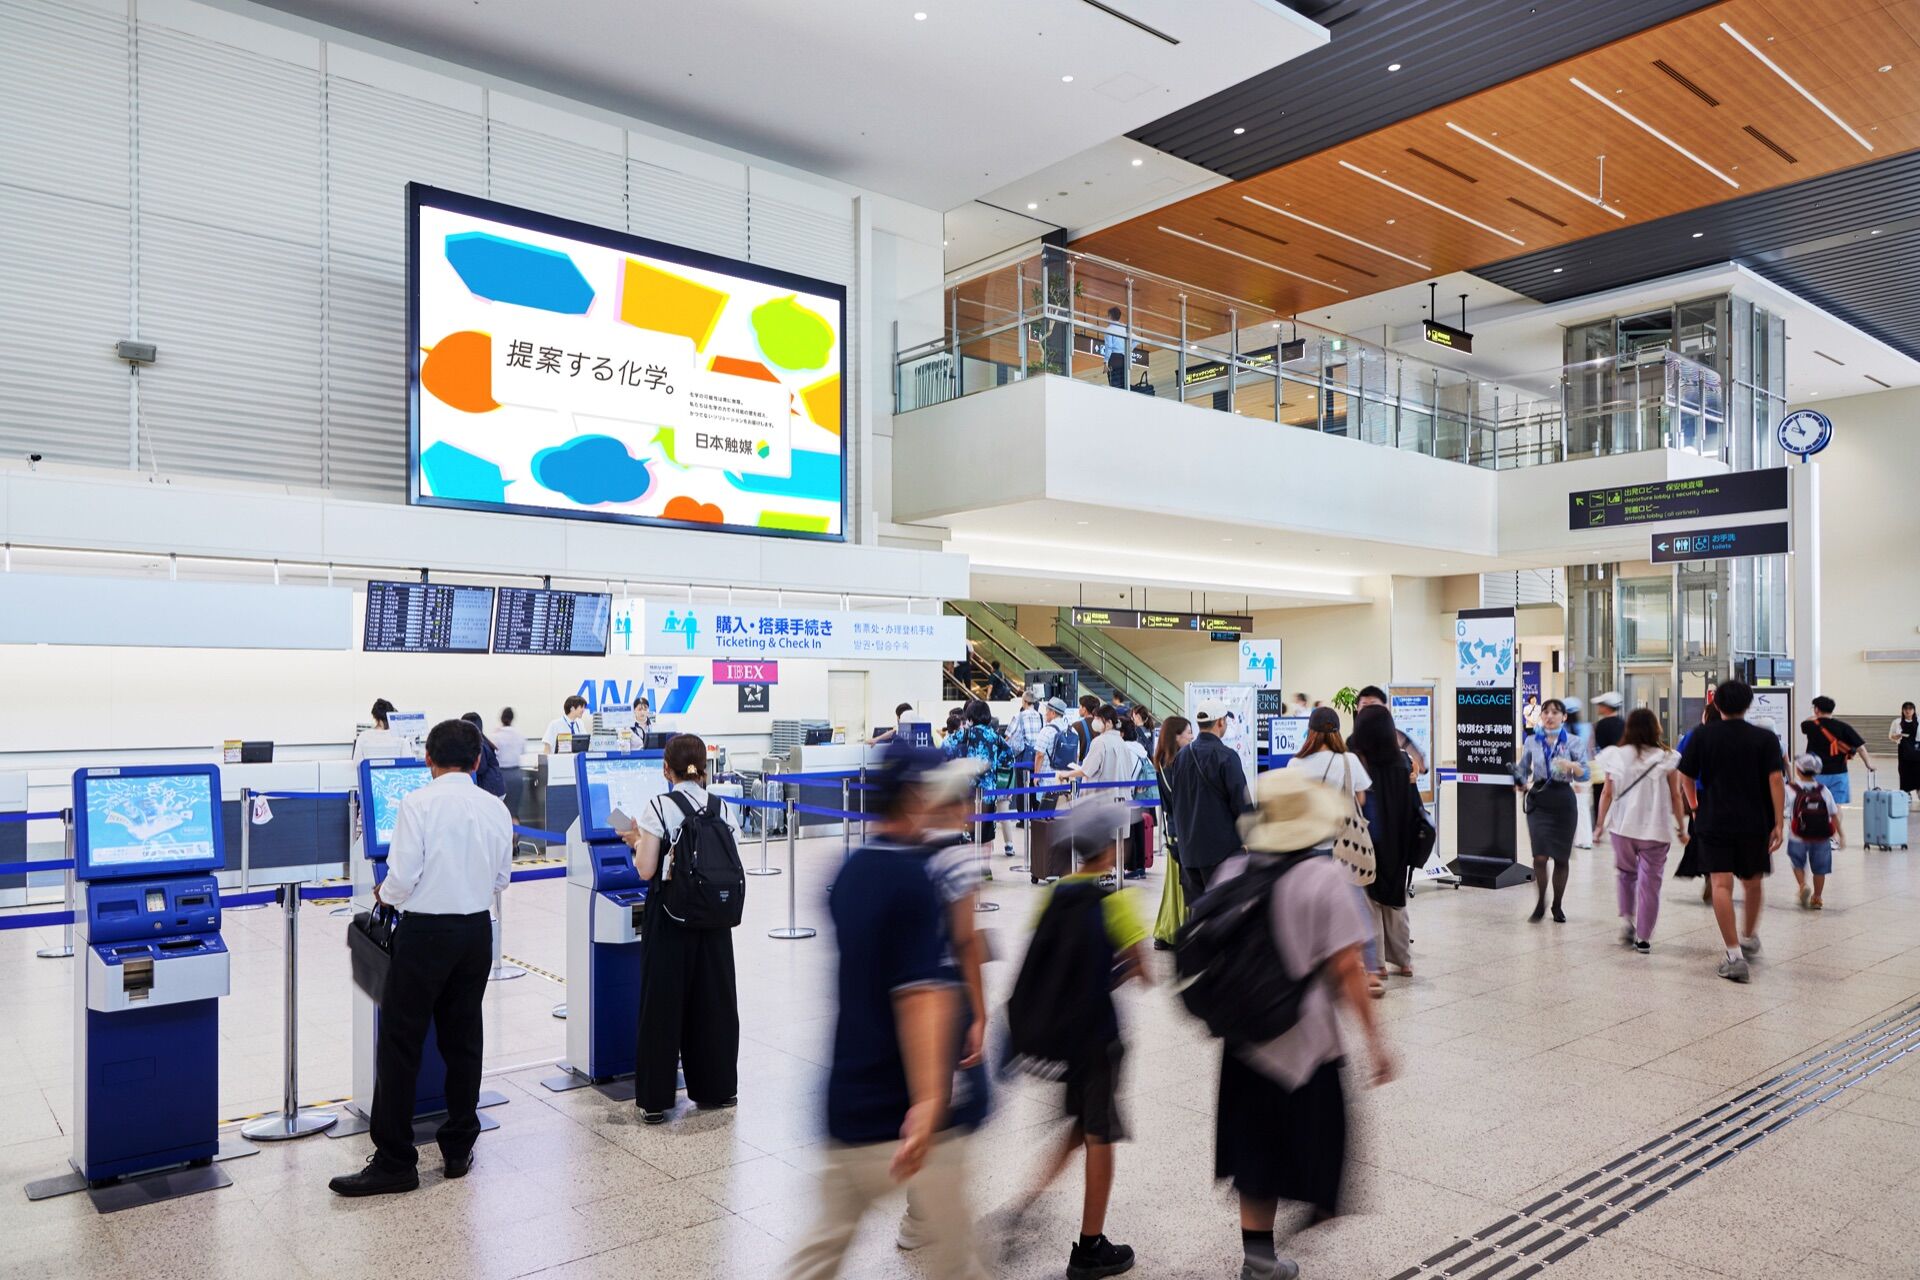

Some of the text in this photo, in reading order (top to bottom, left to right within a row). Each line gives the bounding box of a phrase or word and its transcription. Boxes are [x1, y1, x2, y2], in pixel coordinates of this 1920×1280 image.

[506, 339, 674, 394] 提案する化学。
[696, 432, 752, 455] 日本触媒
[1624, 480, 1704, 497] 出発ロビー 保安検査場
[1624, 487, 1720, 504] departure lobby security check
[1624, 504, 1660, 515] 到着ロビー
[1646, 511, 1664, 520] lobby
[716, 615, 833, 636] 購入・搭乗手続き
[1457, 620, 1466, 637] 6
[716, 635, 822, 650] Ticketing & Check In
[1242, 642, 1251, 656] 6
[727, 664, 764, 680] IBEX
[1270, 702, 1279, 710] IN
[1458, 694, 1512, 705] BAGGAGE
[1457, 723, 1513, 735] 特別な手荷物
[1275, 735, 1295, 750] 10 kg
[1458, 738, 1512, 749] Special Baggage
